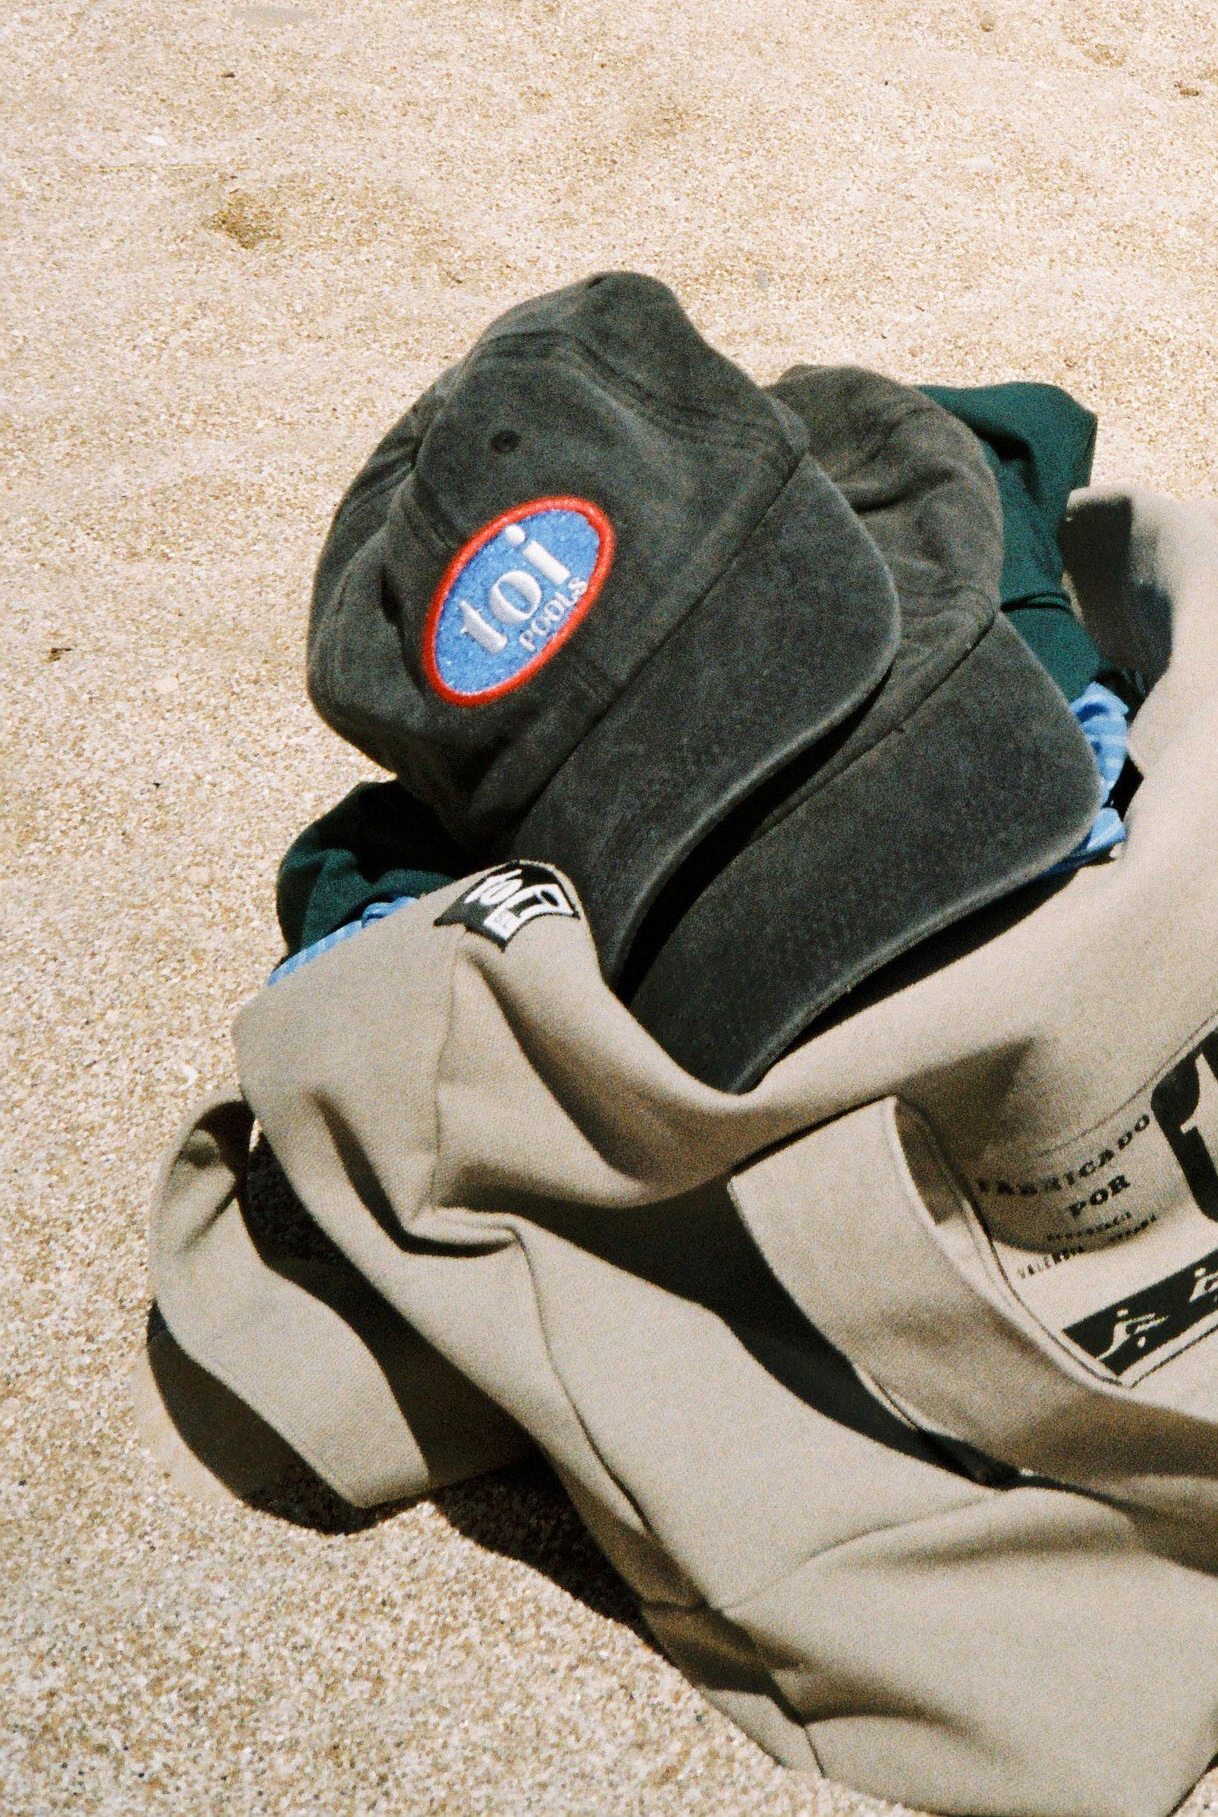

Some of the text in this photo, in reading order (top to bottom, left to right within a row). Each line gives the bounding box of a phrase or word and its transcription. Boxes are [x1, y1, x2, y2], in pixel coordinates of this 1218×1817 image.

[459, 525, 571, 653] toi
[519, 577, 588, 652] POOLS
[1067, 1173, 1131, 1216] POR
